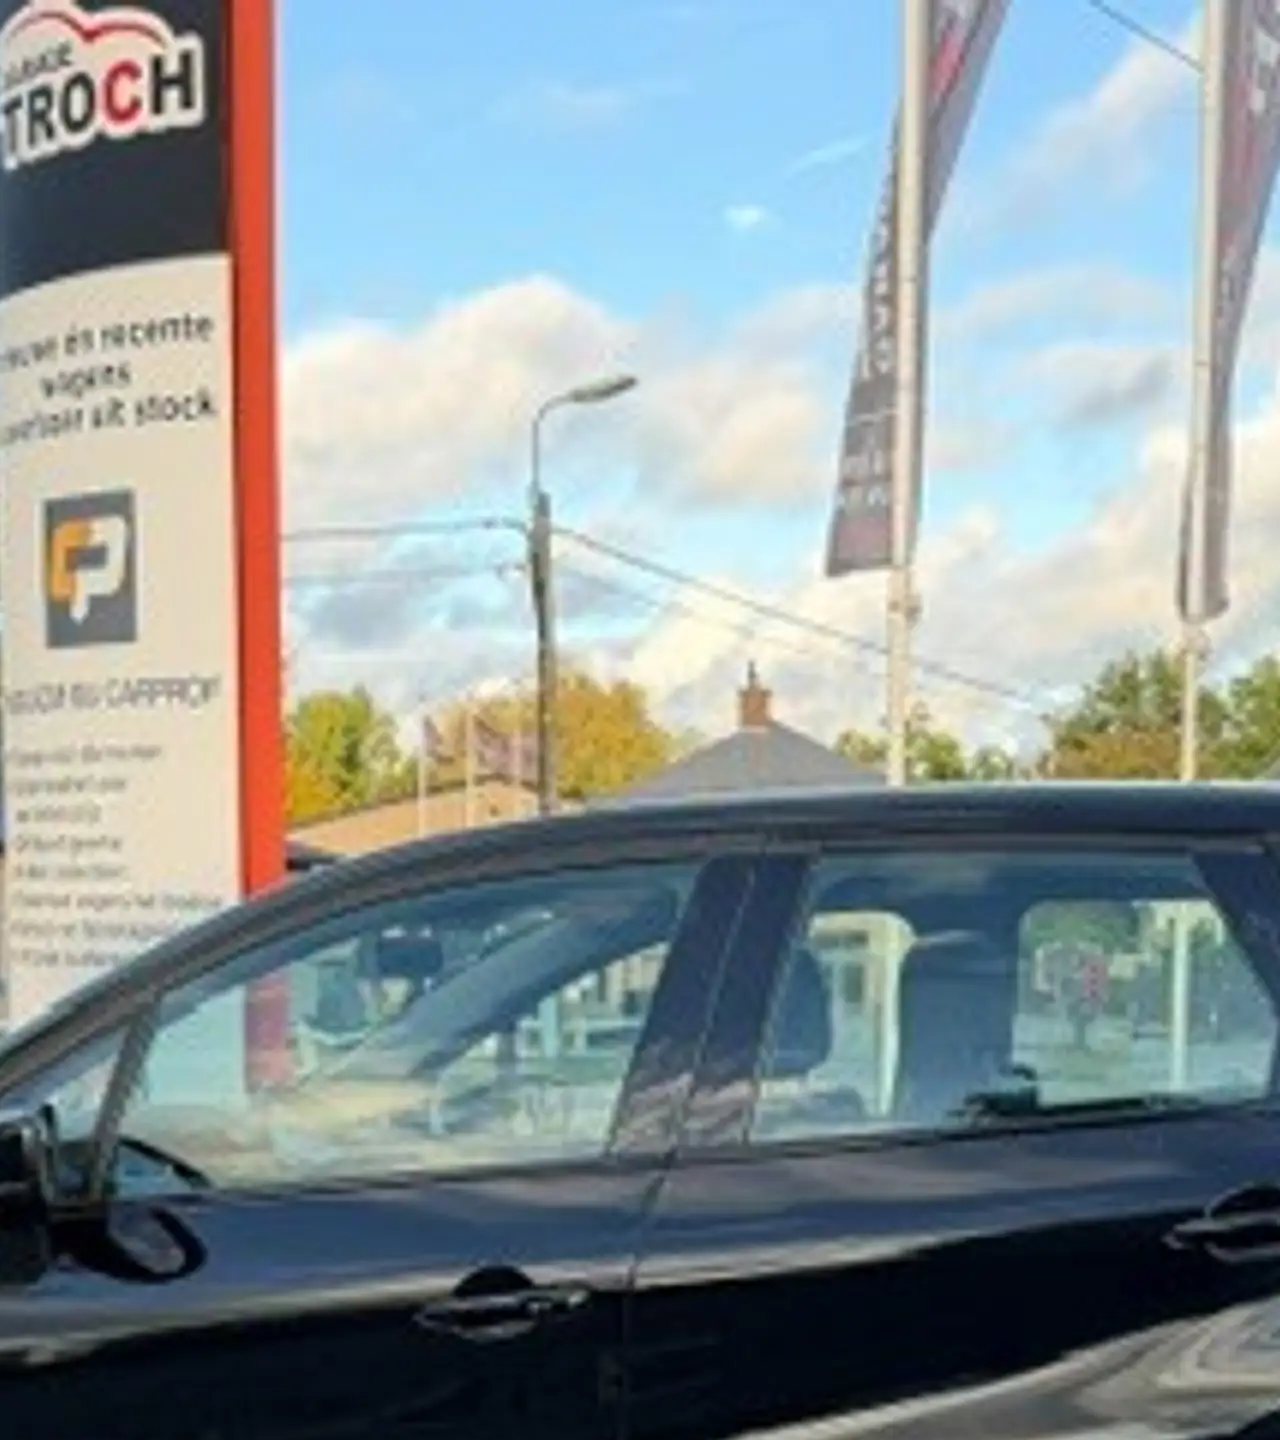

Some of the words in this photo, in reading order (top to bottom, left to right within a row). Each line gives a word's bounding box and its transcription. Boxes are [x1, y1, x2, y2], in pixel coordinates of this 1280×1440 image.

[2, 49, 195, 153] TROCH
[100, 313, 214, 348] recente
[136, 386, 216, 427] stock
